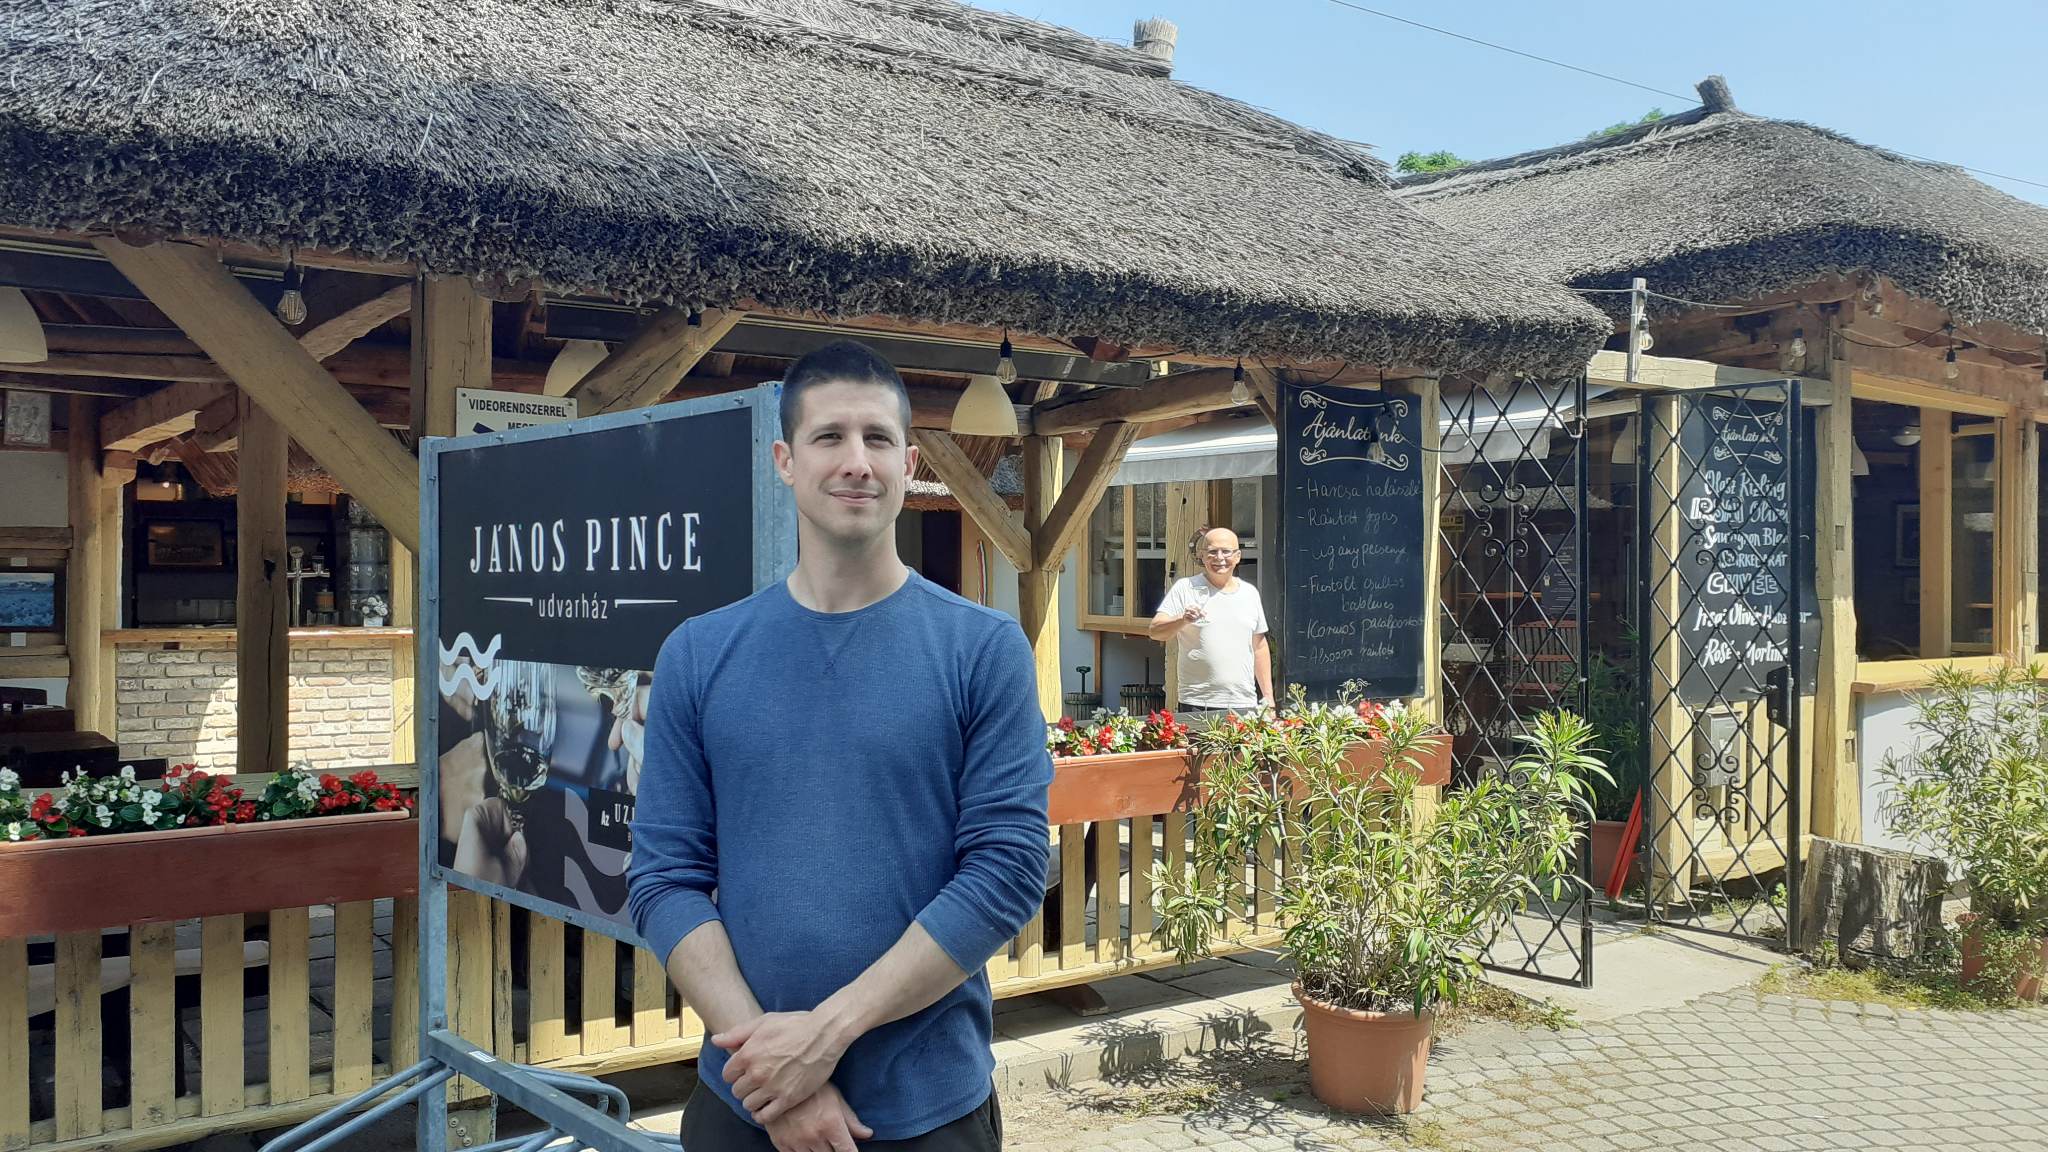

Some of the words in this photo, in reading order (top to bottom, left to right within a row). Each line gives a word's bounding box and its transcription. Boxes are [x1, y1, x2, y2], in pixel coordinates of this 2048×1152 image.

[468, 398, 568, 418] VIDEORENDSZERREL
[1302, 410, 1406, 448] Ajánlatnk
[1307, 478, 1361, 500] Harcsa
[469, 519, 566, 573] JÁNOS
[585, 512, 702, 572] PINCE
[538, 592, 608, 619] udvarház
[600, 809, 610, 827] Az
